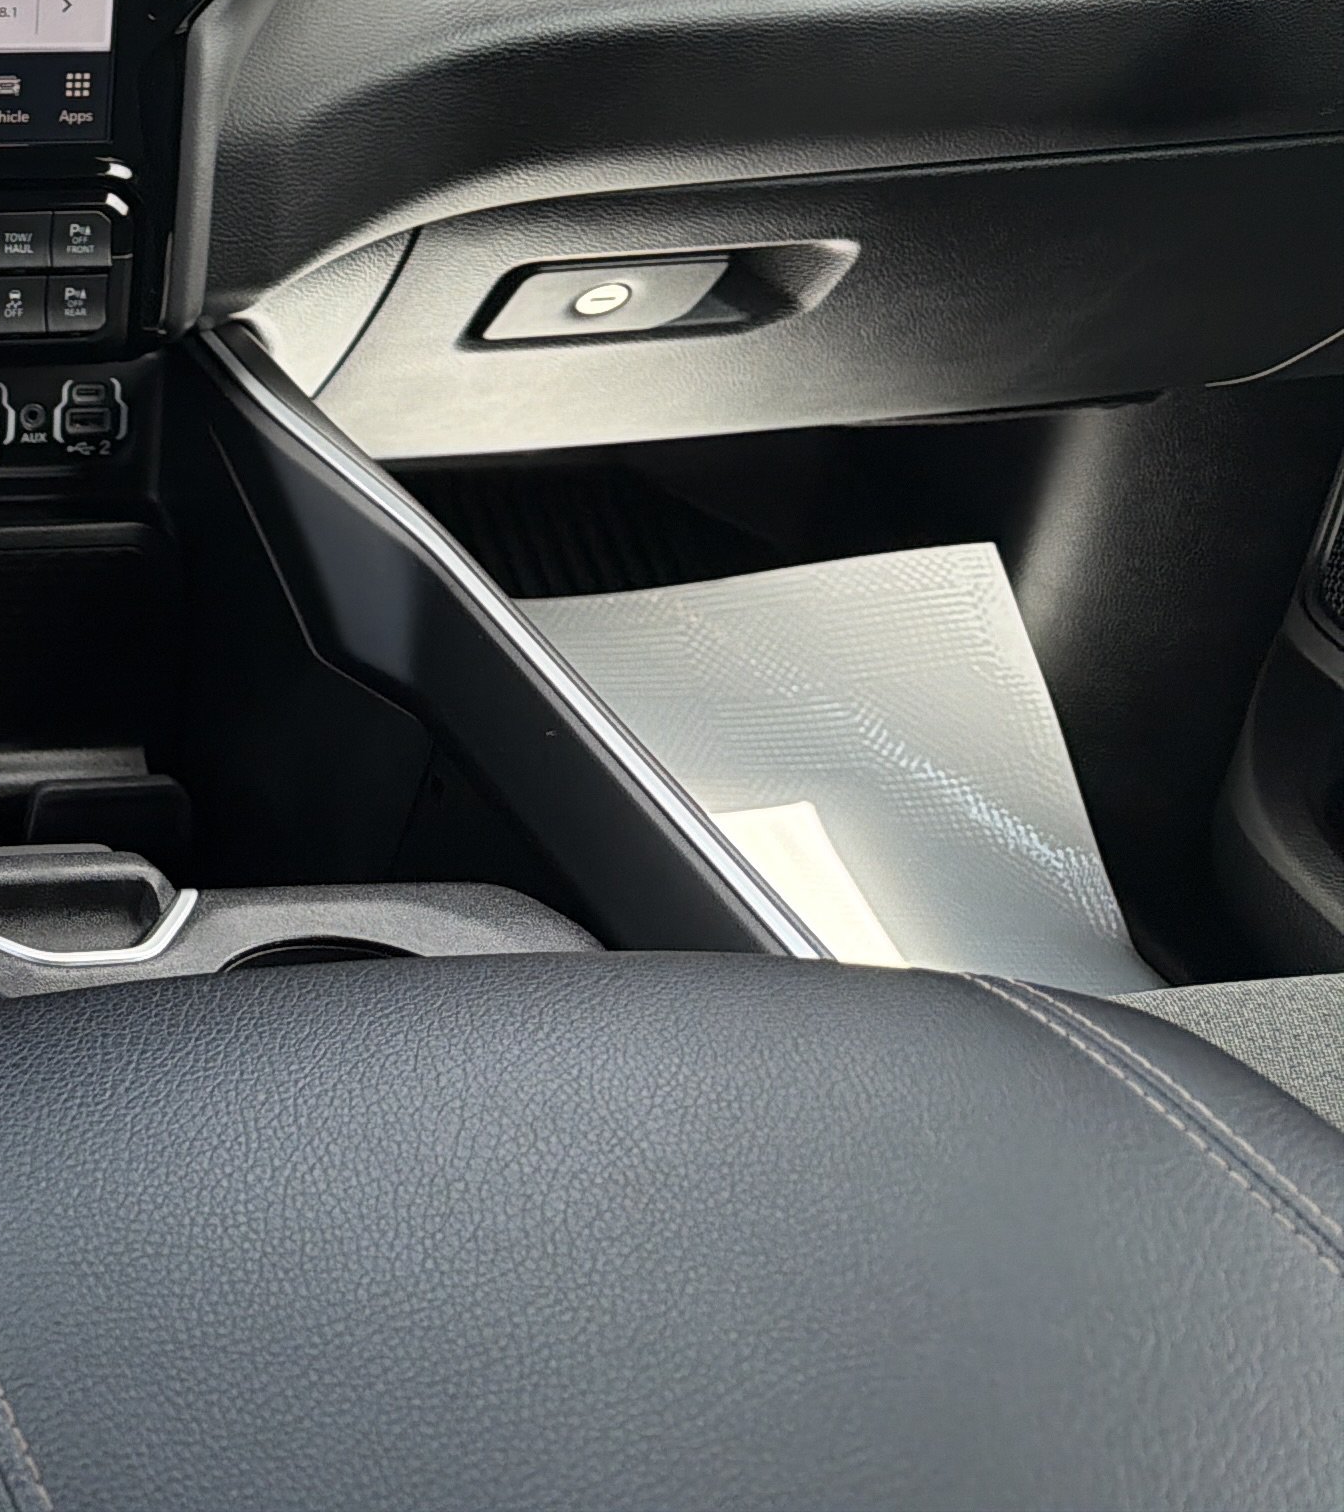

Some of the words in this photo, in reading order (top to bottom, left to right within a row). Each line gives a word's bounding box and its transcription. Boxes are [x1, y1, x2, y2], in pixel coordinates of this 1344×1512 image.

[59, 110, 94, 124] Apps
[4, 232, 33, 244] TOW/
[4, 244, 34, 255] HAUL
[67, 244, 95, 254] FRONT
[4, 308, 23, 318] OFF
[64, 308, 87, 317] REAR
[20, 432, 48, 444] AUX
[98, 440, 111, 455] 2
